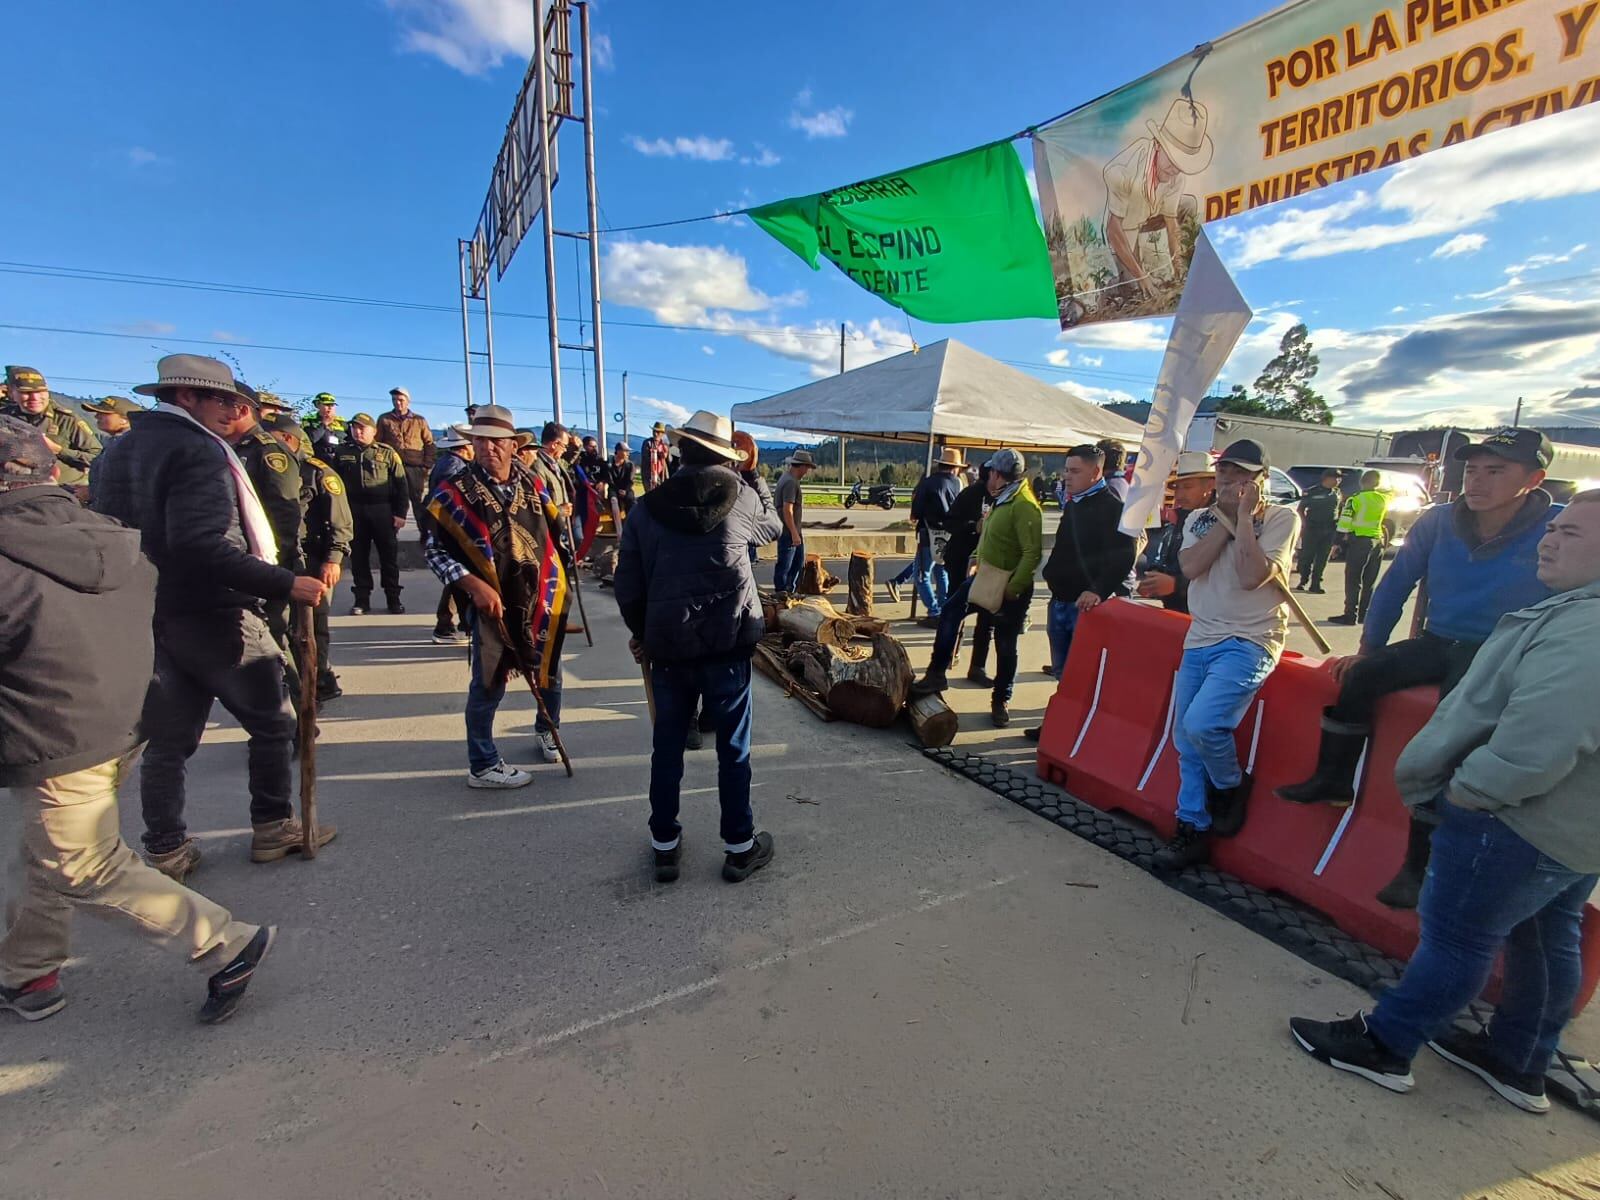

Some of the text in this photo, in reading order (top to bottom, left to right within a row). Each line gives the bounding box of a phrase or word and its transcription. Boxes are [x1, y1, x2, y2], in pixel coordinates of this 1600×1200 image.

[1260, 2, 1599, 160] TERRITORIOS. Y
[1266, 0, 1516, 98] POR LA PER
[1204, 188, 1243, 223] DE
[1248, 130, 1432, 210] NUESTRAS
[847, 225, 942, 260] ESPINO
